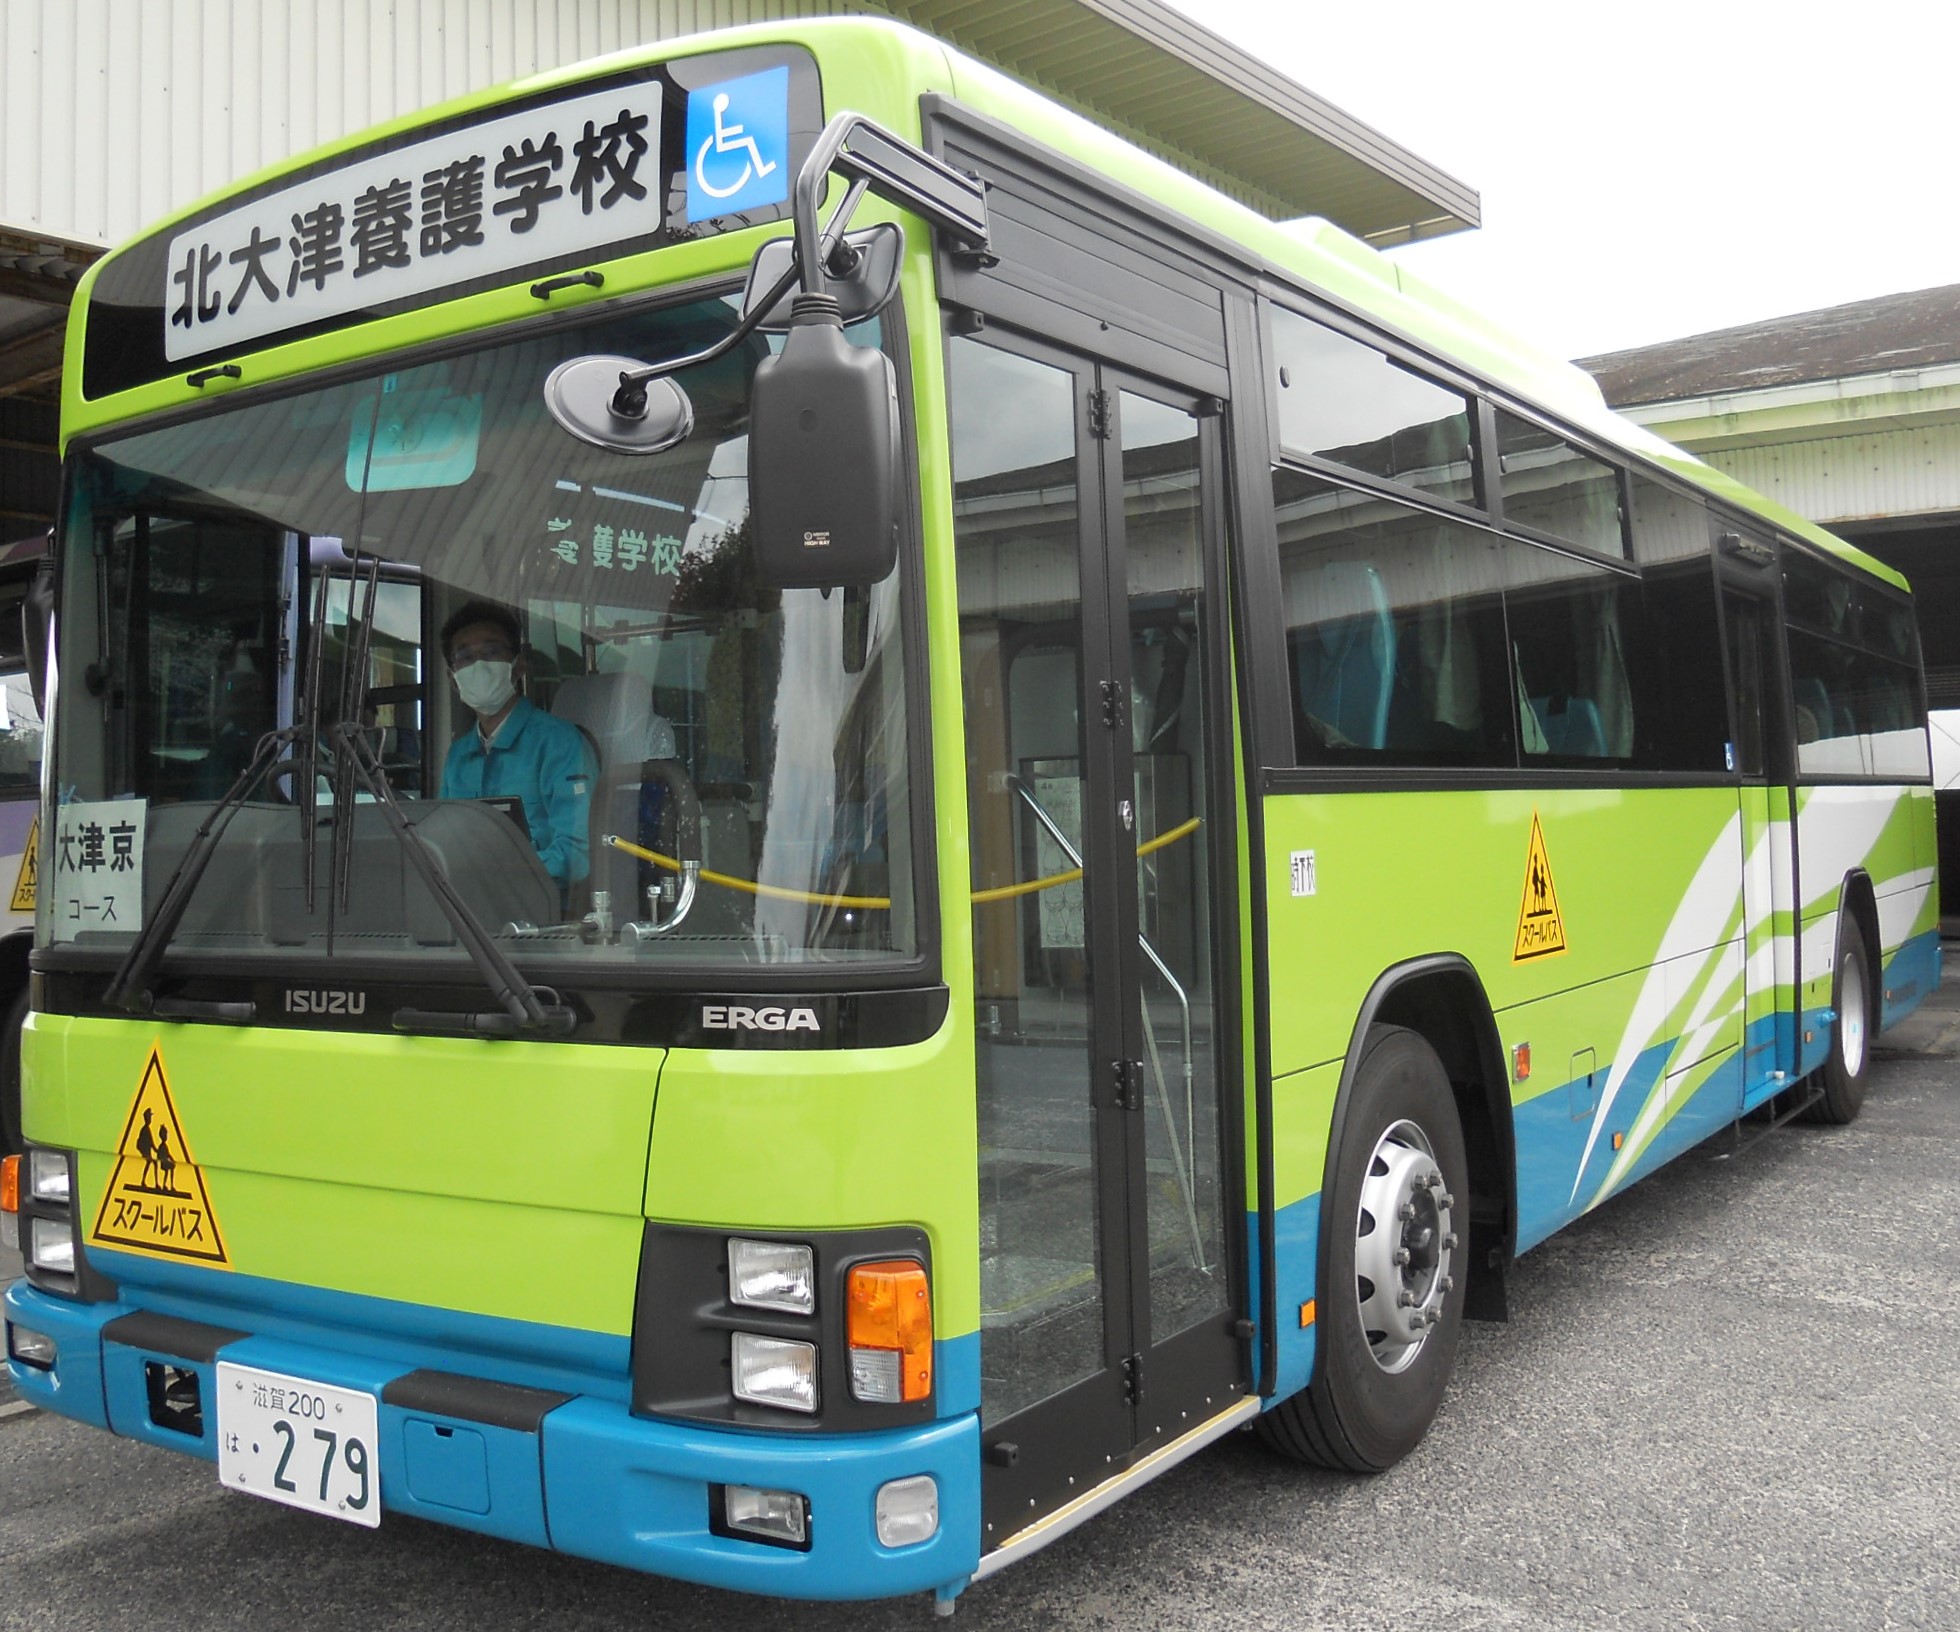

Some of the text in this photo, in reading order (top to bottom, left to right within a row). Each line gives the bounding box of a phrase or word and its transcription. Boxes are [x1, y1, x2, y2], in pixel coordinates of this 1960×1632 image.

[171, 108, 649, 330] 北大津養護学校
[59, 820, 137, 873] 大津京
[69, 896, 117, 921] コース
[1522, 919, 1558, 948] スクールバス
[285, 990, 366, 1014] ISUZU
[702, 1005, 821, 1031] ERGA
[112, 1197, 203, 1242] スクールバス
